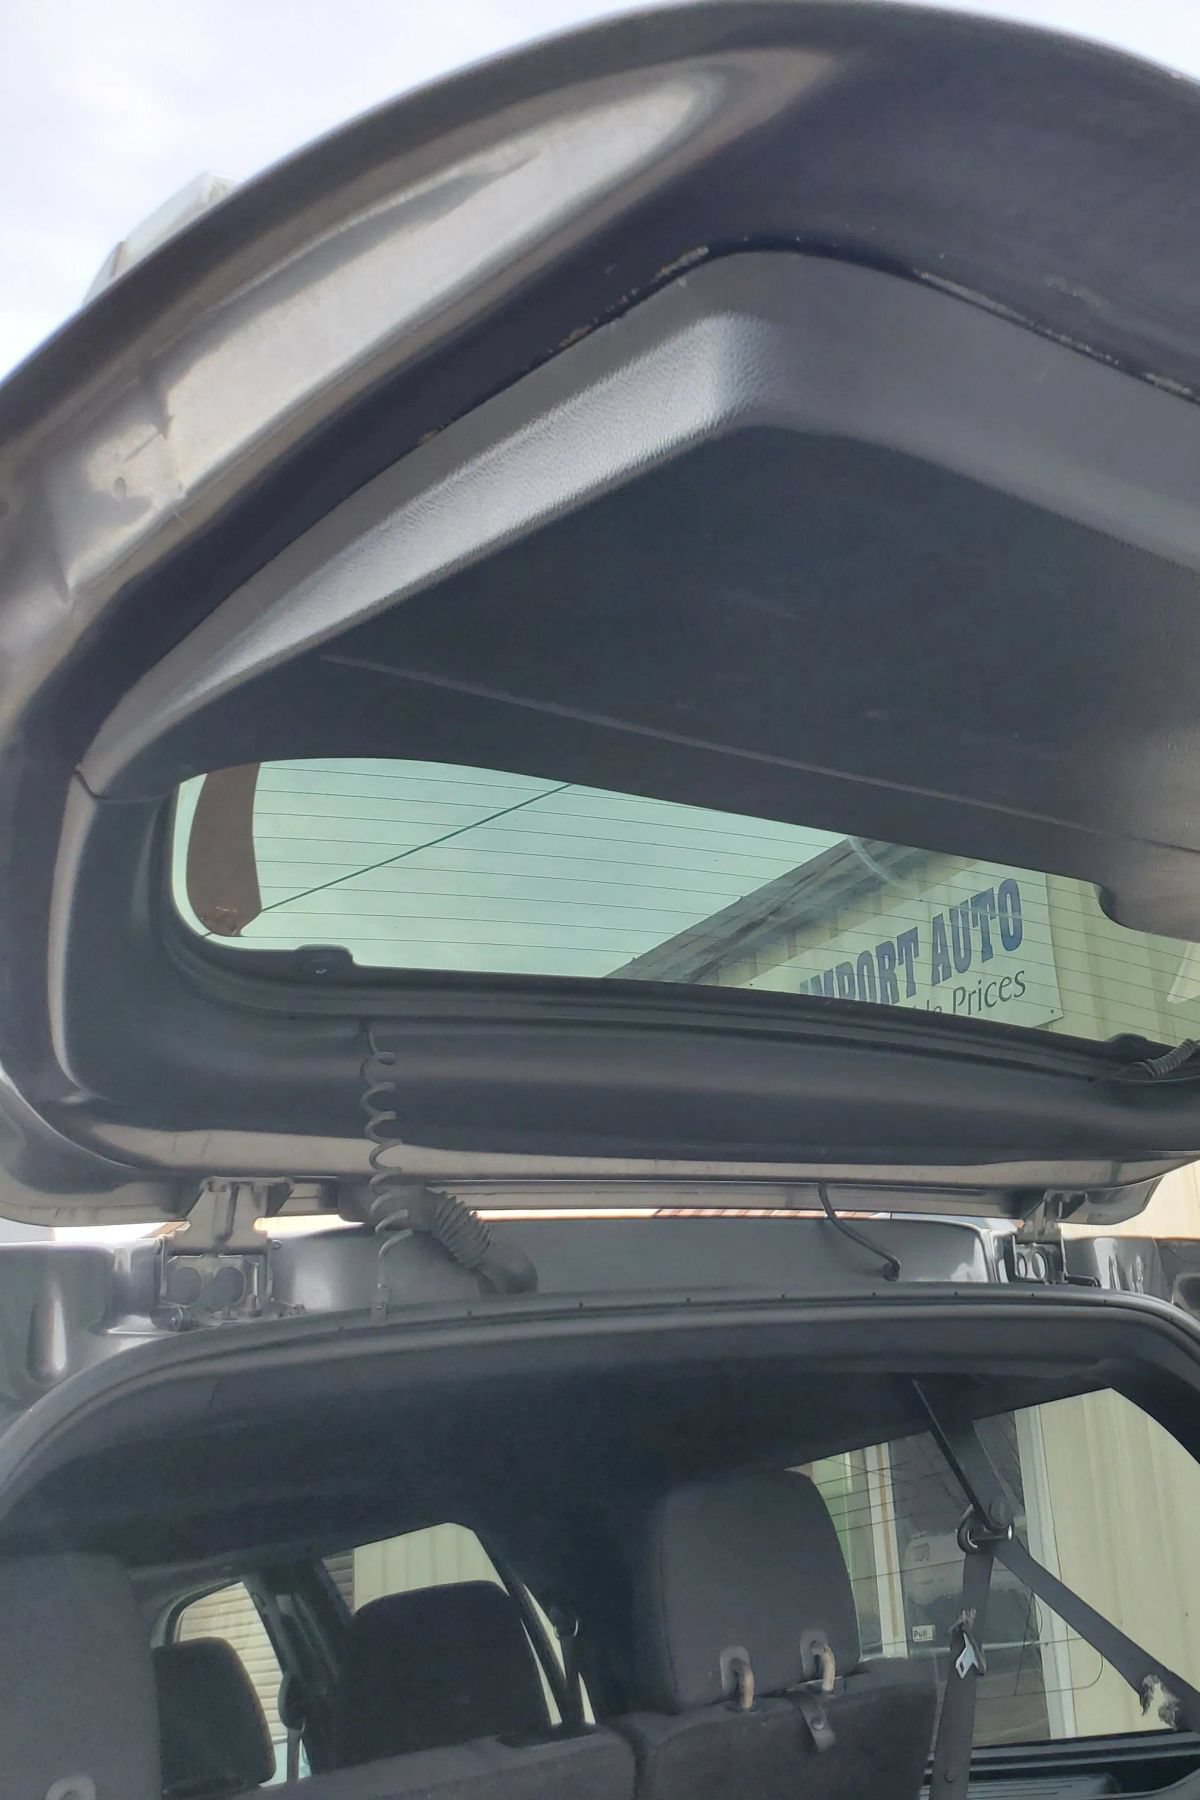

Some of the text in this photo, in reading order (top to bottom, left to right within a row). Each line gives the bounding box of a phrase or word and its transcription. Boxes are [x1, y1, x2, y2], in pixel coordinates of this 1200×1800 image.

[800, 878, 1024, 1005] PORT AUTO
[952, 970, 1026, 1015] Prices
